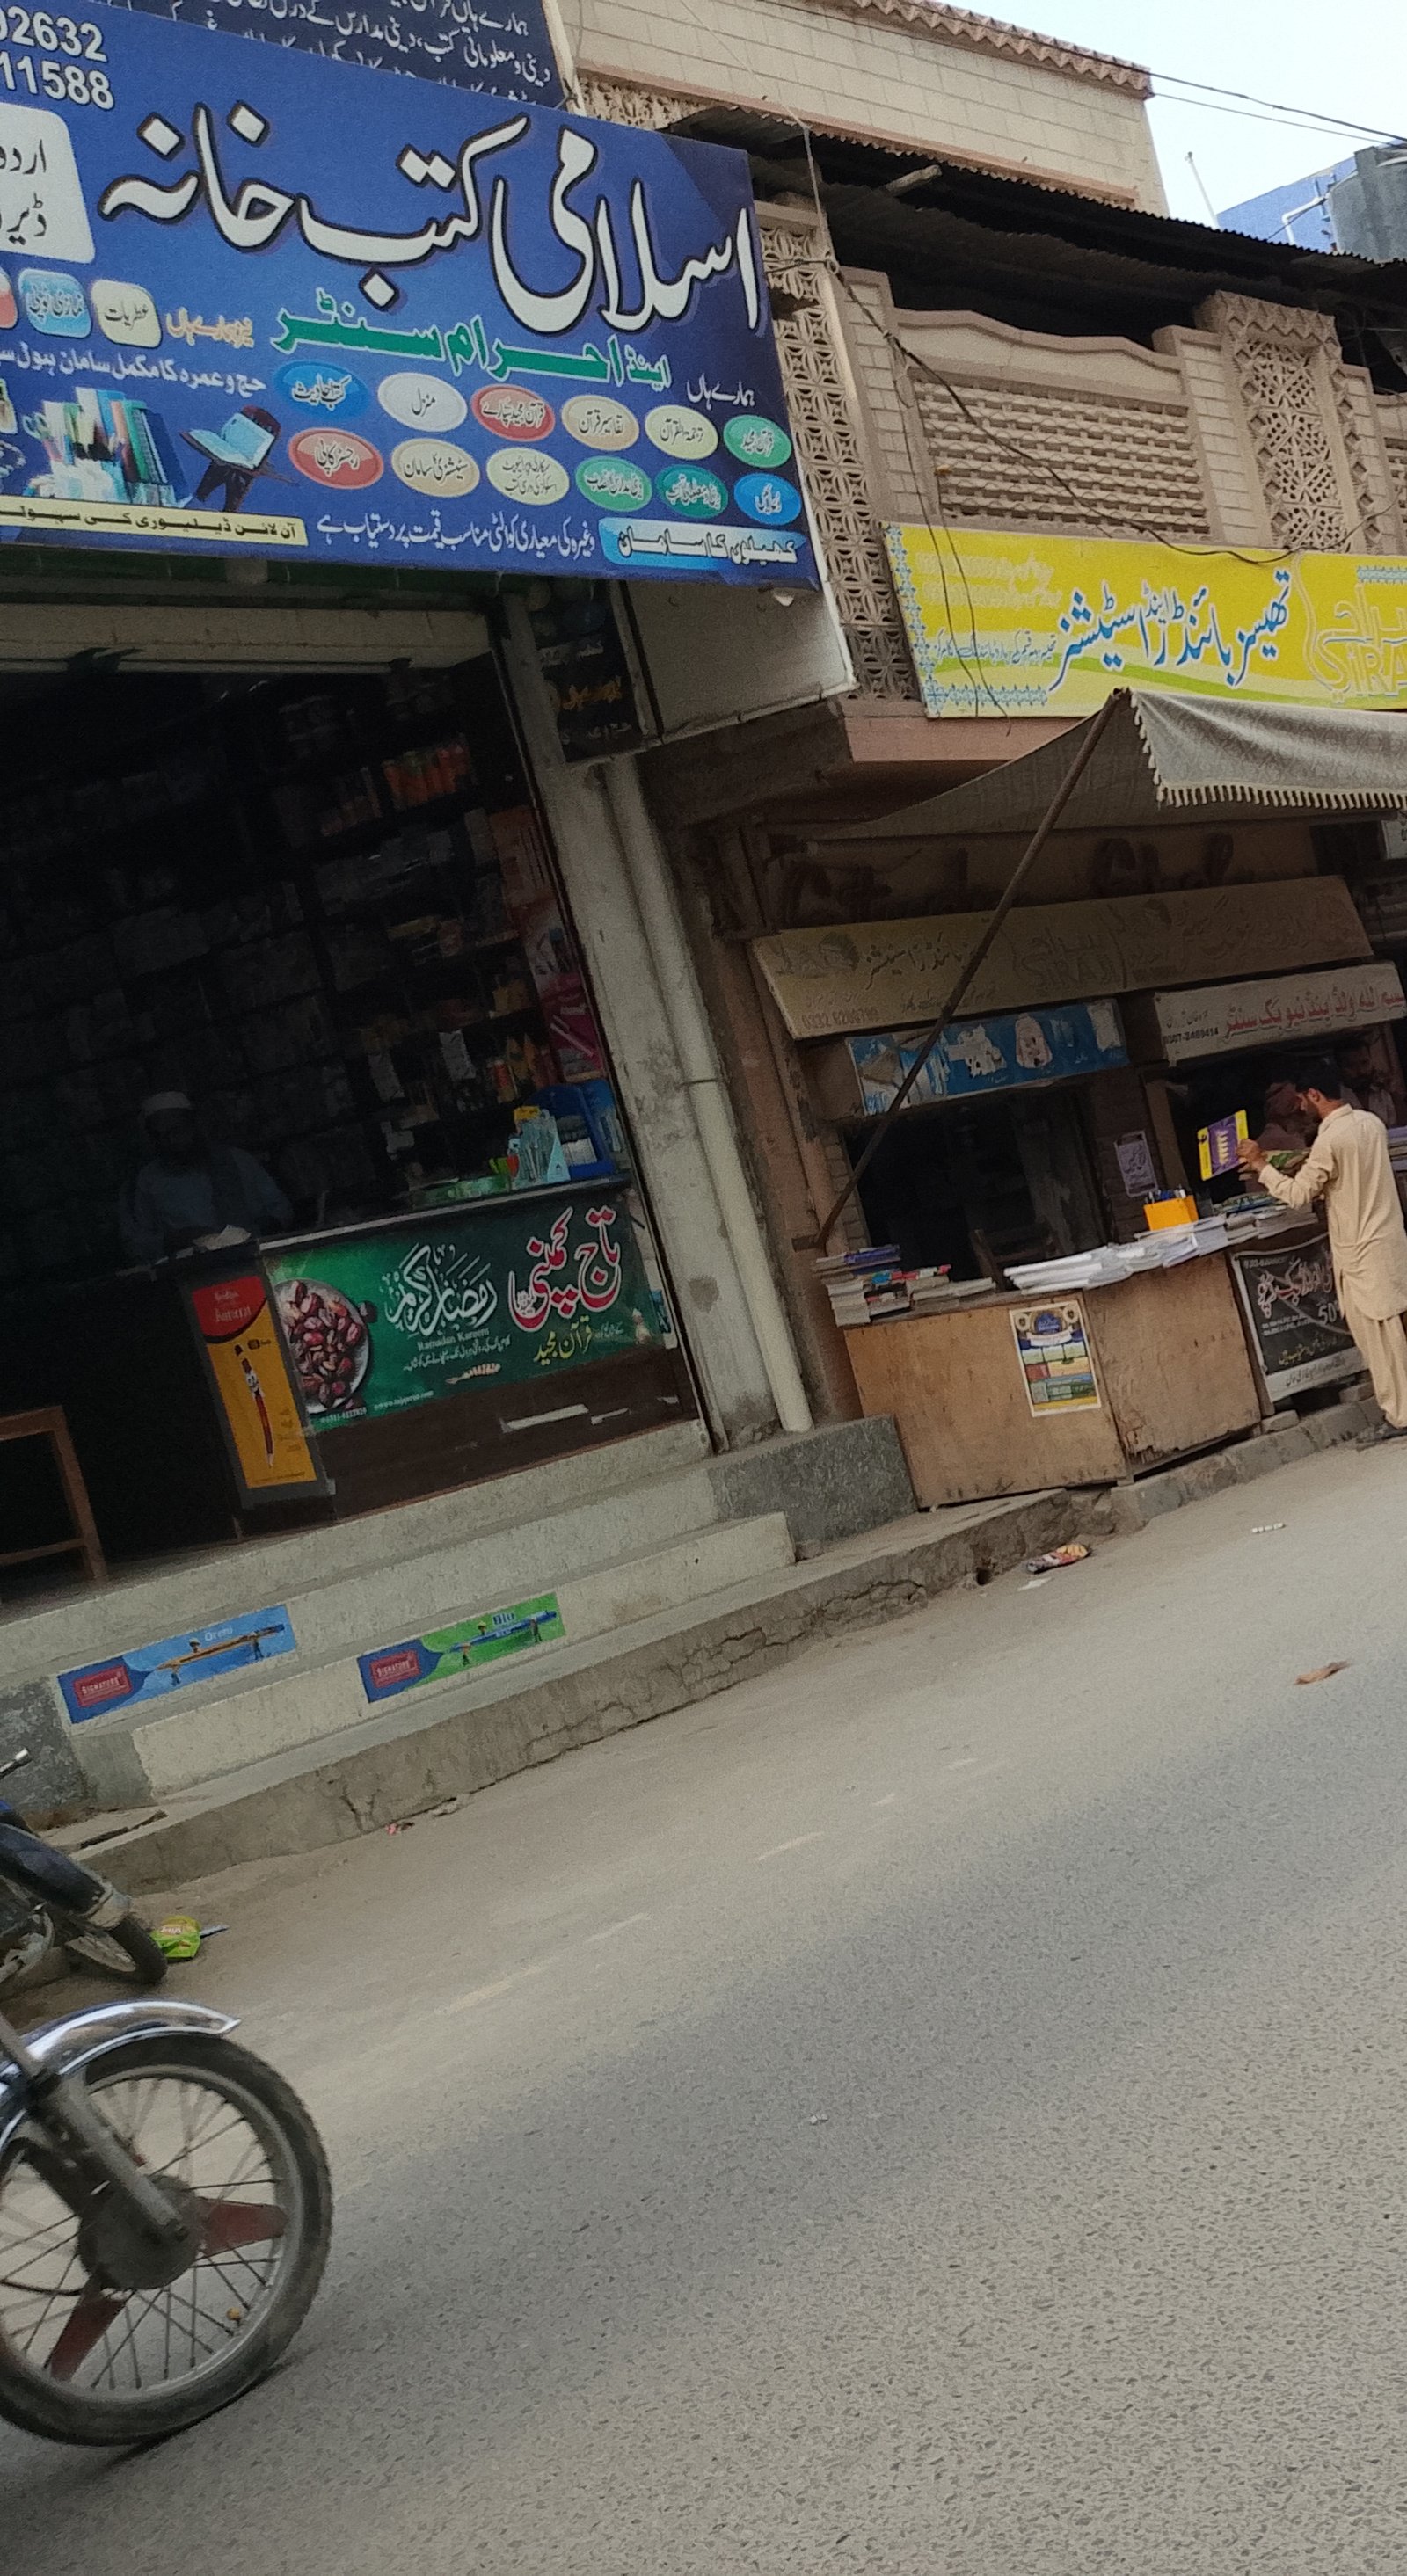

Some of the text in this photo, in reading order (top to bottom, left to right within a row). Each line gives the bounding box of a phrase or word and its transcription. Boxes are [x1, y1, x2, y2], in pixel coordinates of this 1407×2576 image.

[0, 192, 47, 246] ڈیر
[98, 99, 762, 336] اسلامی کتب خانہ
[269, 287, 446, 363] سنٹر
[444, 314, 626, 389] احرام
[711, 381, 755, 408] ہمارے
[574, 1204, 623, 1312] تاج
